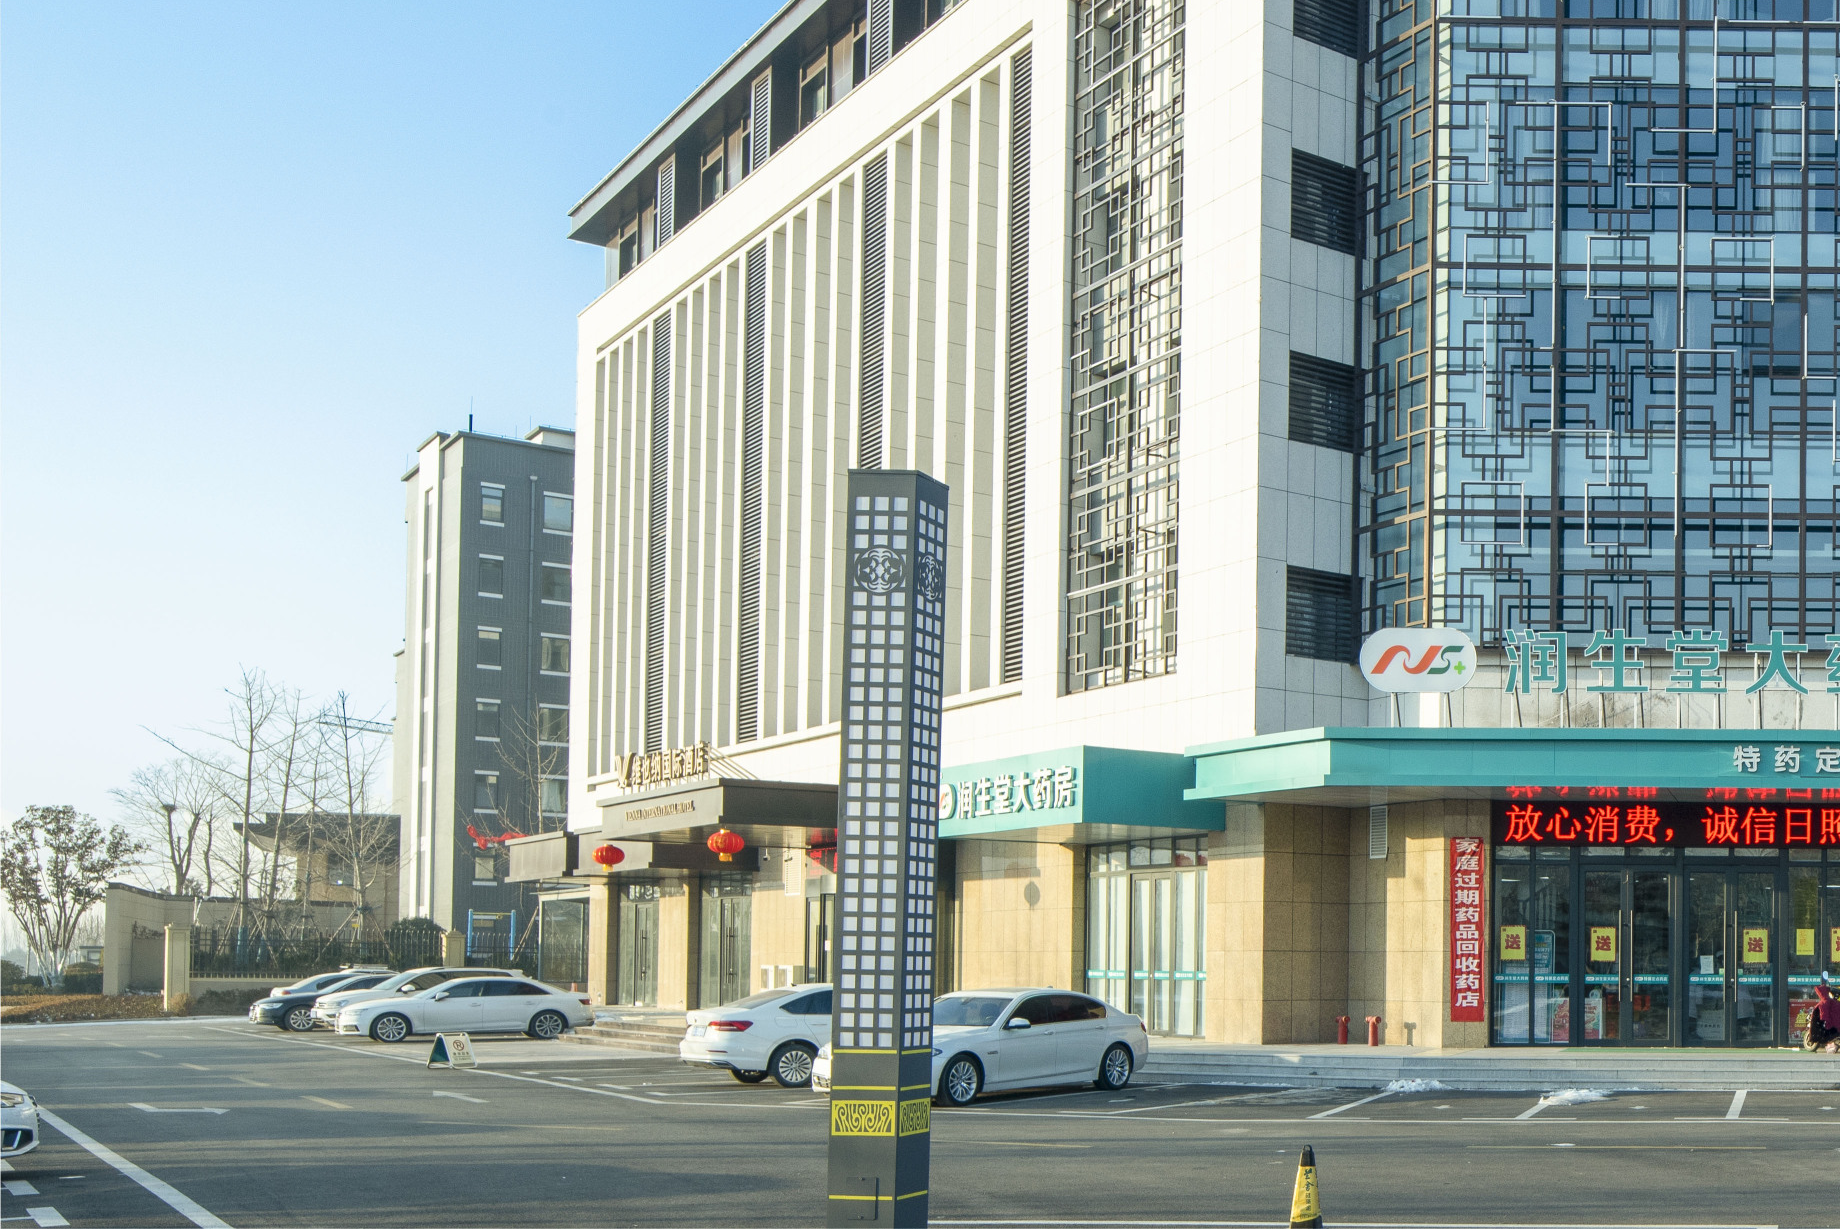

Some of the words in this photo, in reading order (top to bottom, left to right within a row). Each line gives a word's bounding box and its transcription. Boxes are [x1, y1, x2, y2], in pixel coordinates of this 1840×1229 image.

[957, 765, 1077, 820] 润生堂大药房
[1505, 803, 1675, 844] 放心消费，
[1454, 837, 1481, 1008] 家庭过期药品回收药店
[1504, 933, 1522, 950] 送
[1595, 935, 1612, 952] 送
[1747, 936, 1764, 953] 送
